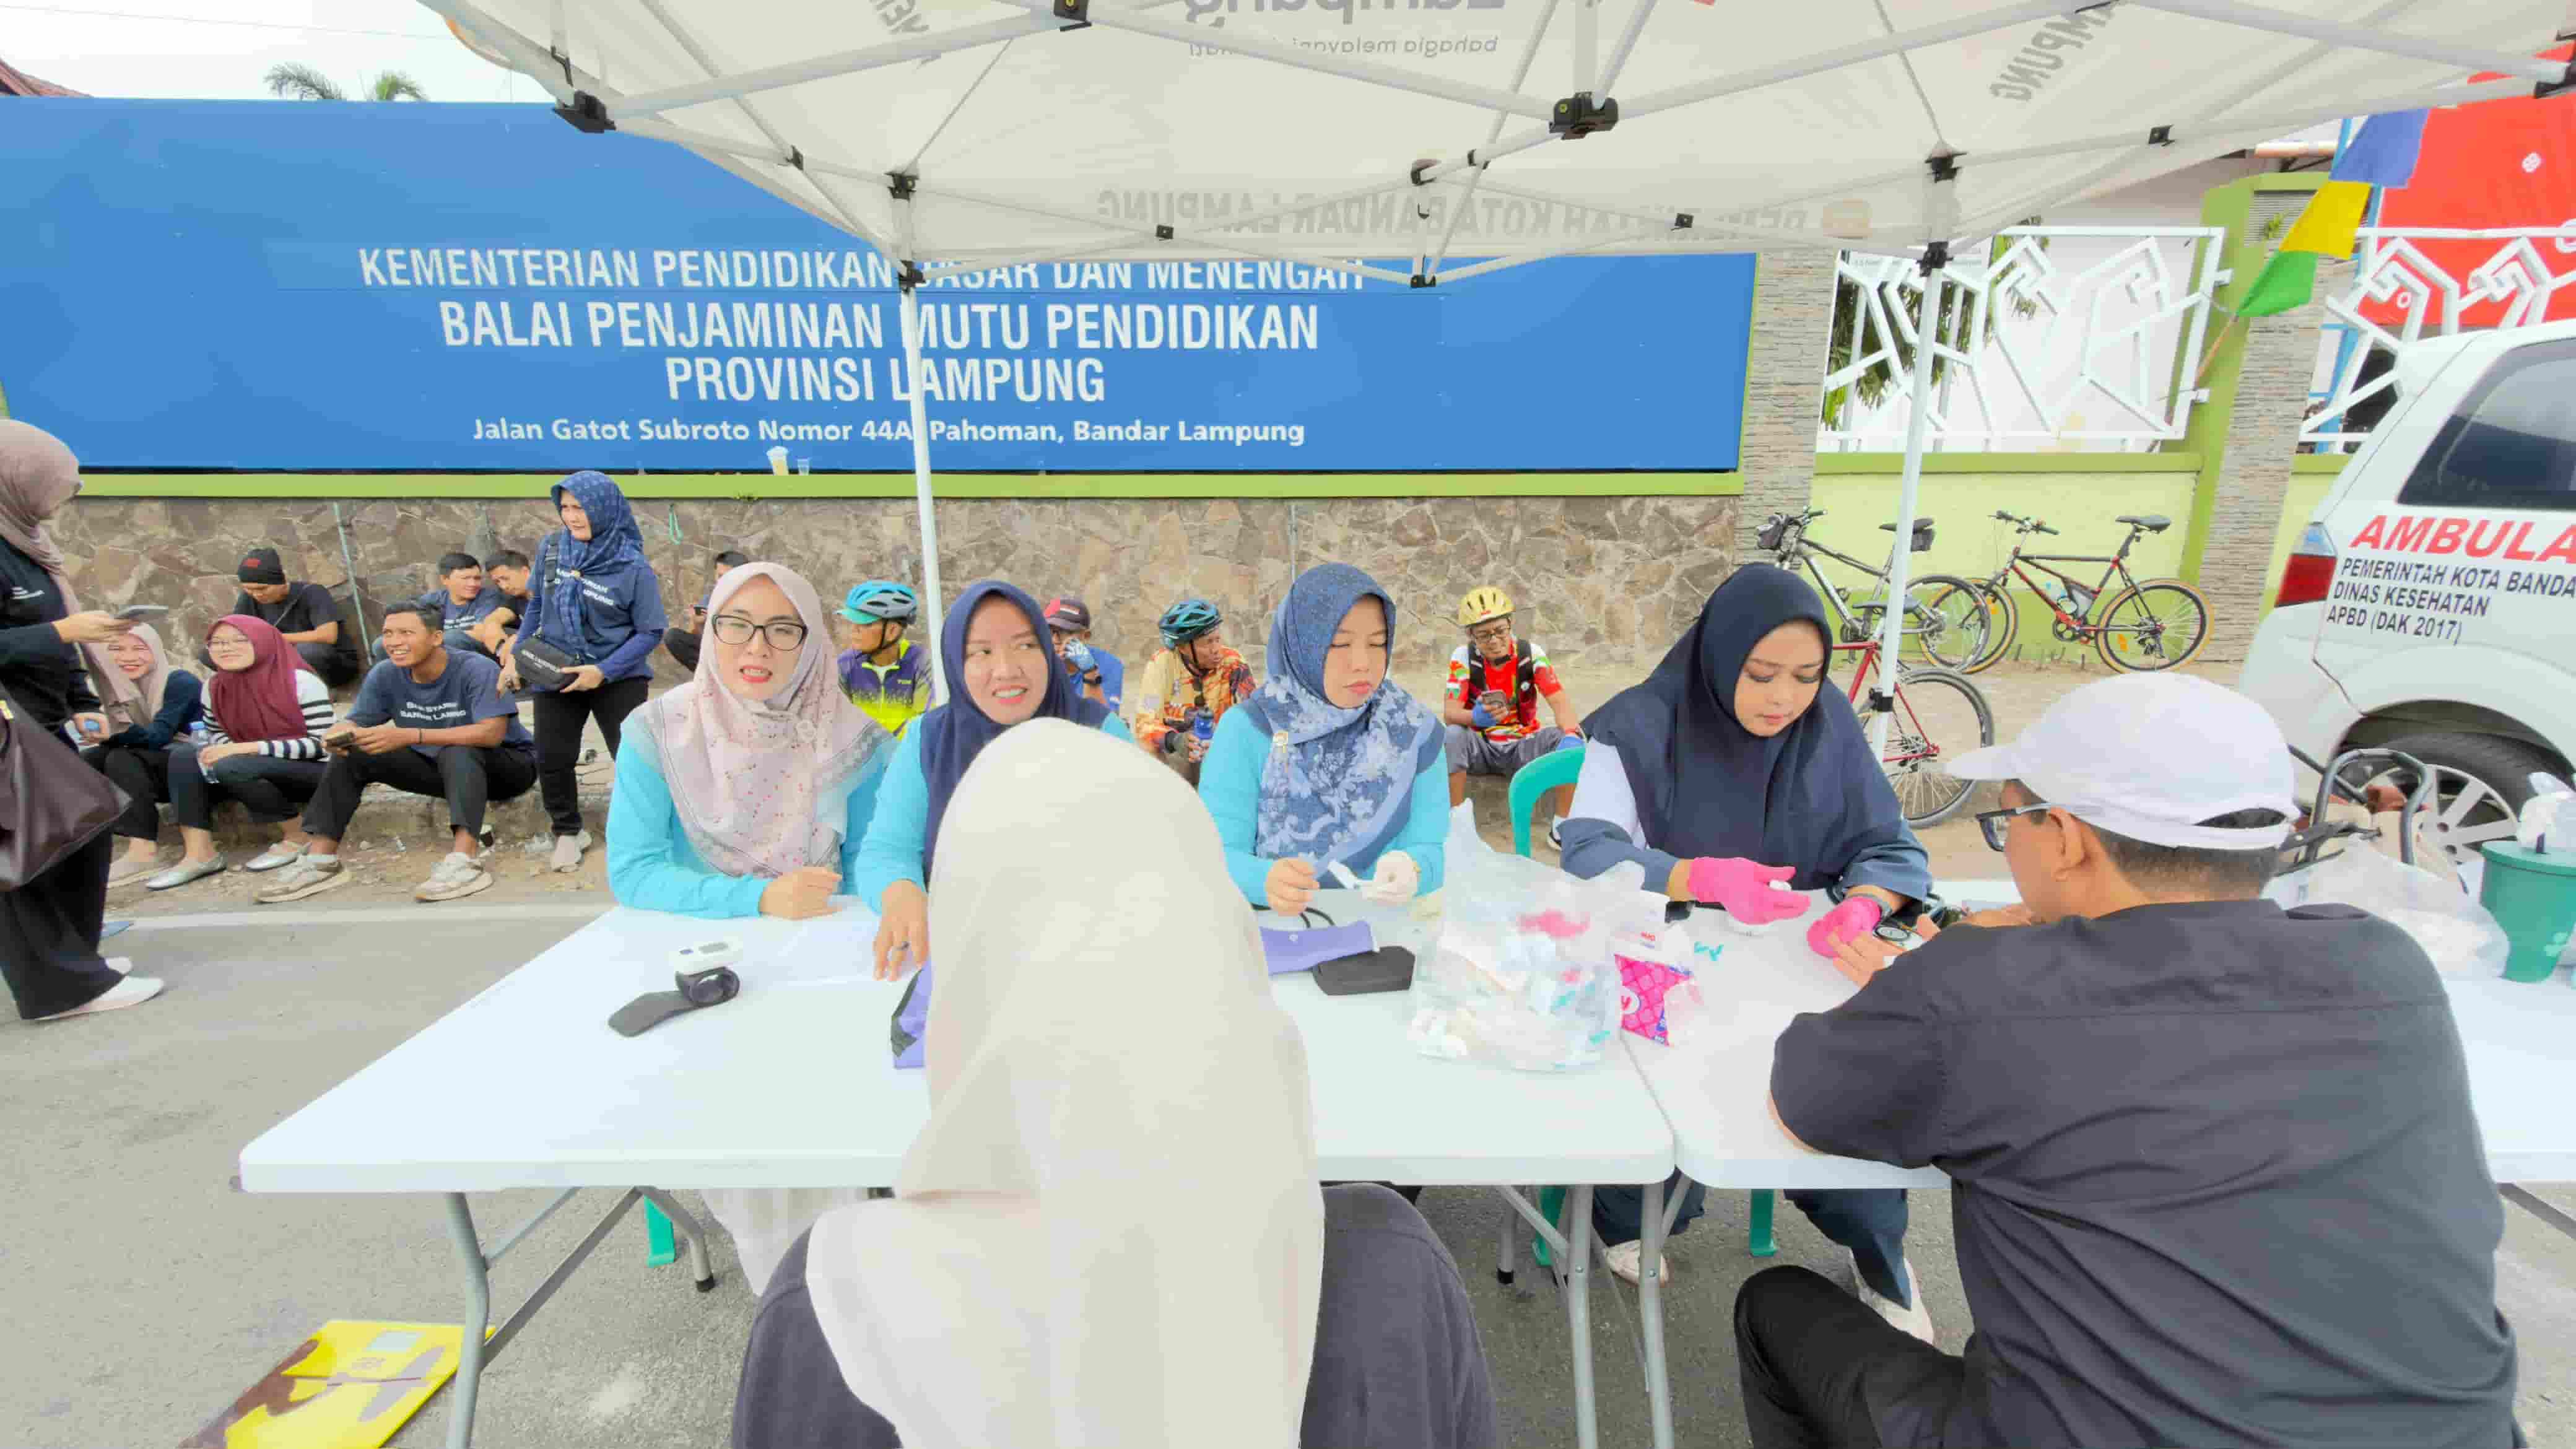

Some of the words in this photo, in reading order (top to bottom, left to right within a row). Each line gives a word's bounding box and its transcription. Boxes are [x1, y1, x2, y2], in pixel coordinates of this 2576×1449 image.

[359, 248, 640, 287] KEMENTERIAN
[653, 249, 893, 288] PENDIDIKAN
[1053, 261, 1131, 289] DAN
[440, 301, 572, 347] BALAI
[586, 302, 882, 348] PENJAMINAN
[1046, 303, 1318, 349] PENDIDIKAN
[666, 356, 874, 401] PROVINSI
[890, 357, 1105, 402] LAMPUNG
[474, 417, 542, 440] Jalan
[552, 419, 630, 440] Gatot
[638, 418, 749, 440] Subroto
[759, 420, 853, 440] Nomor
[930, 419, 1064, 443] Pahoman,
[1074, 419, 1170, 441] Bandar
[1178, 420, 1304, 446] Lampung
[2348, 515, 2576, 564] AMBULA
[2341, 557, 2447, 585] PEMERINTAH
[2450, 566, 2500, 590] KOTA
[2506, 571, 2576, 598] BANDA
[2333, 580, 2380, 604] DINAS
[2384, 586, 2491, 617] KESEHATAN
[2326, 604, 2367, 627] APBD
[2370, 609, 2411, 634] (DAK
[2414, 617, 2463, 646] 2017)
